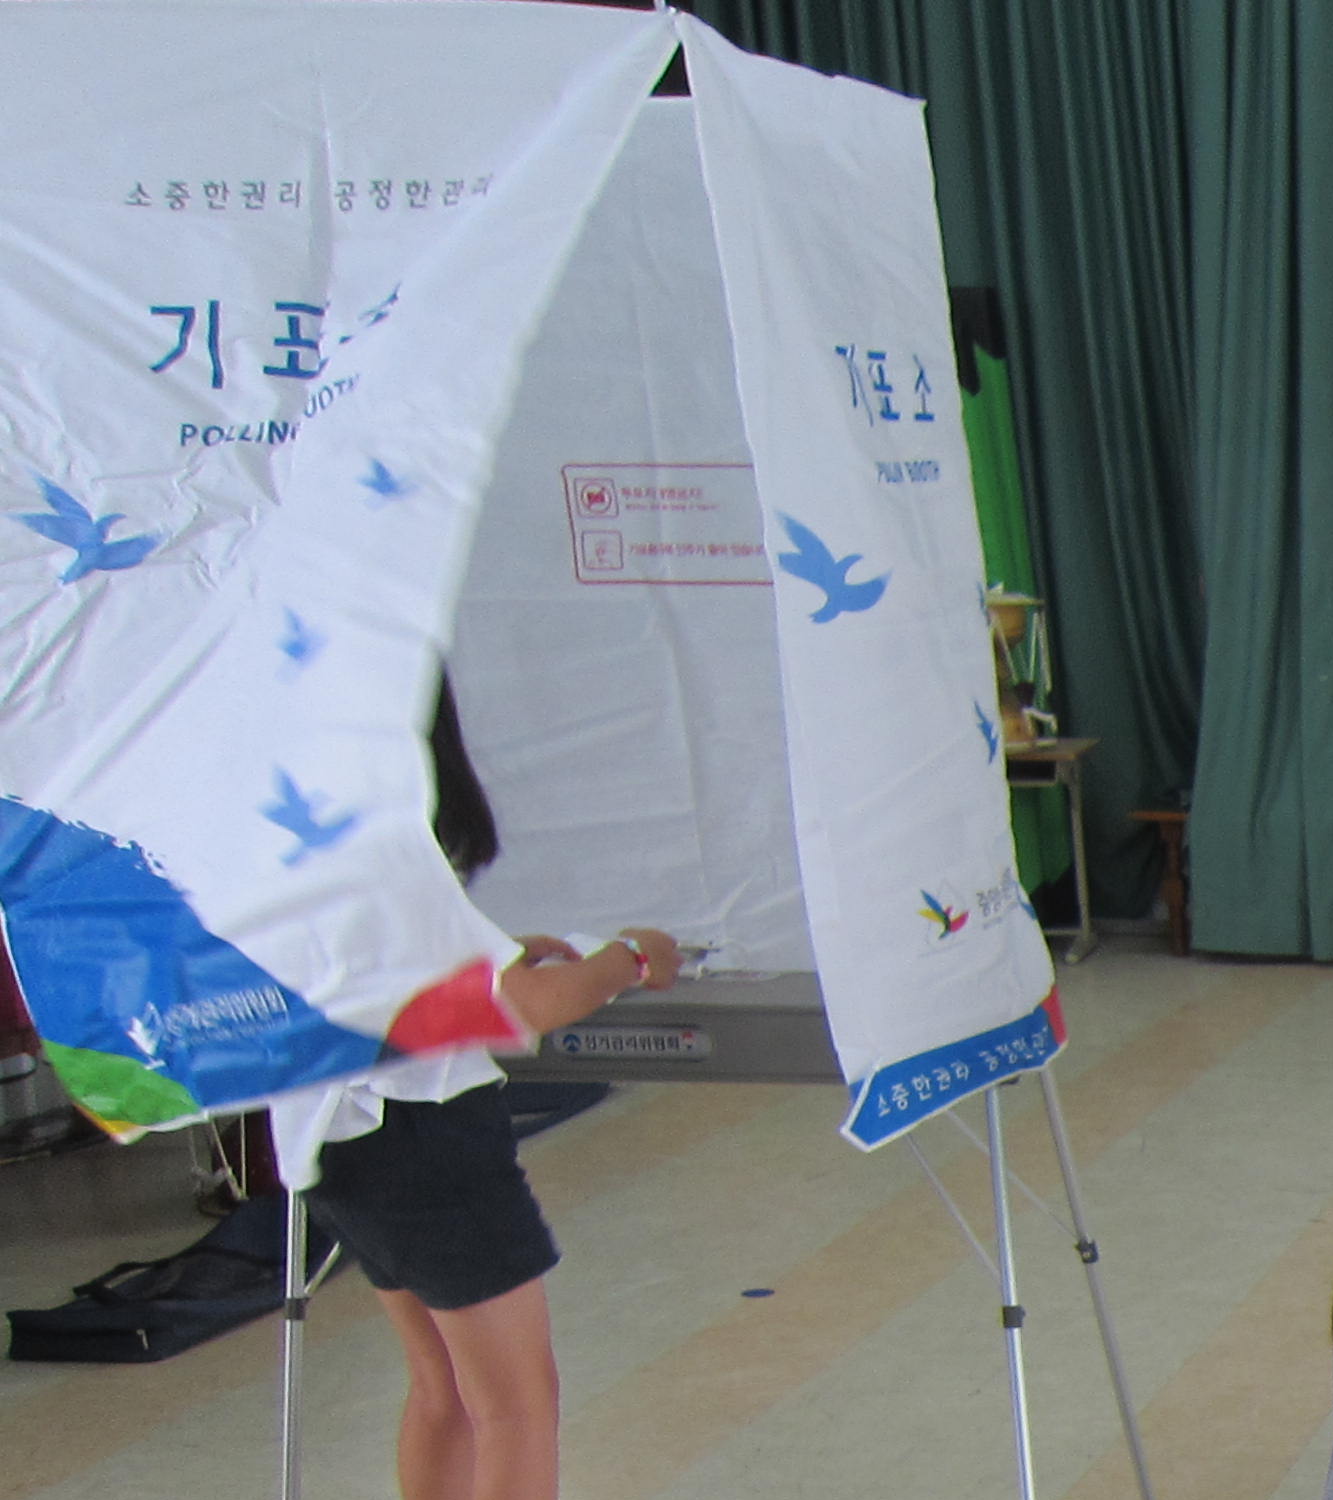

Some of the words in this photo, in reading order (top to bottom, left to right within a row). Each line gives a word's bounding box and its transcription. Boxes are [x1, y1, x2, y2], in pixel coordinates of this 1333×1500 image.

[125, 180, 301, 212] 소중한권리
[149, 281, 402, 390] 기표
[179, 420, 301, 447] POLLIN
